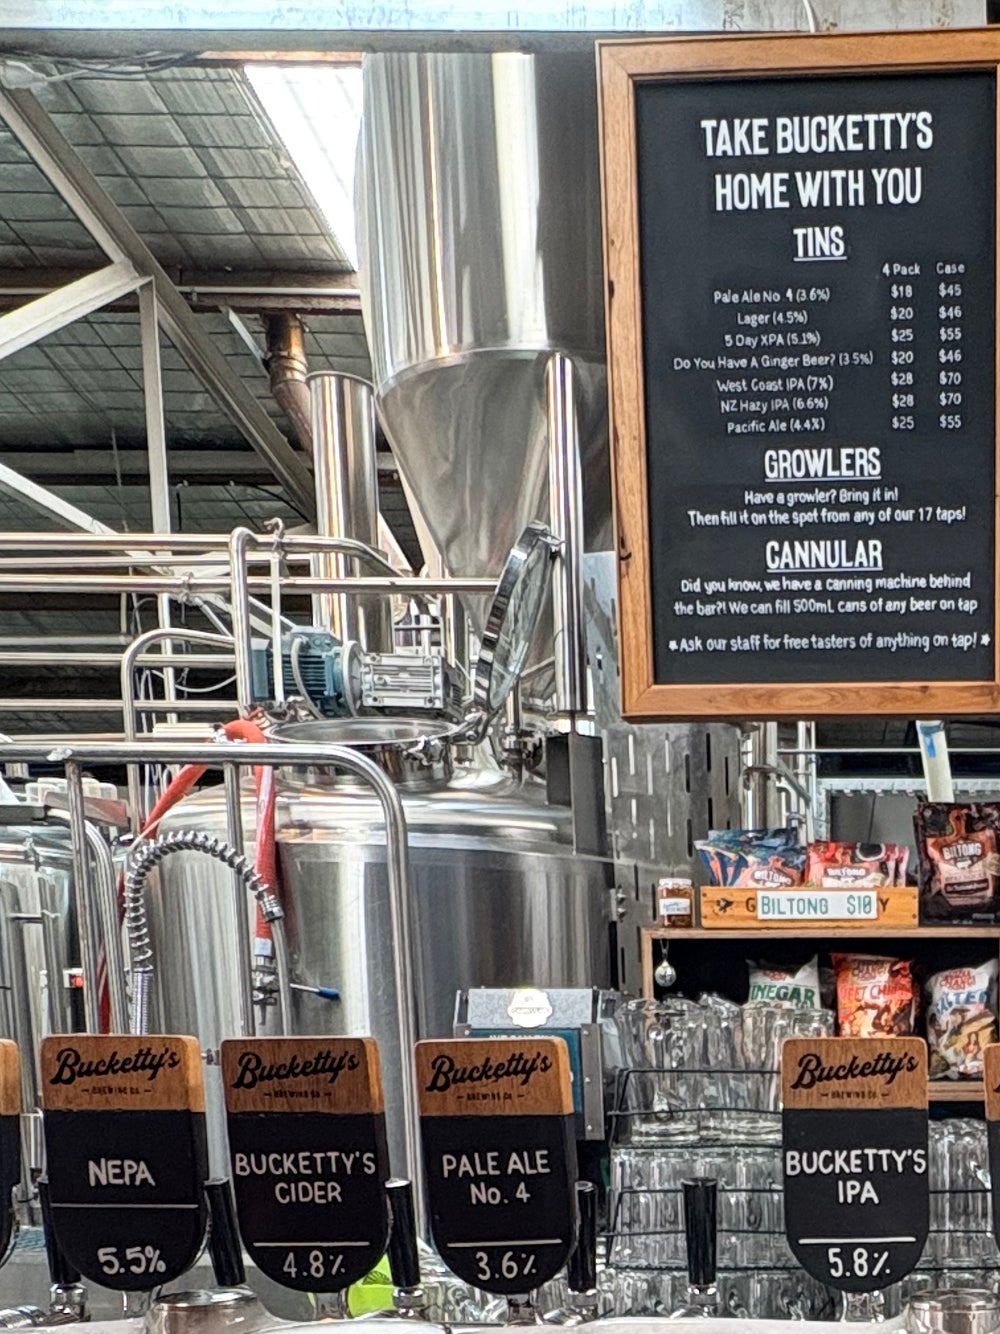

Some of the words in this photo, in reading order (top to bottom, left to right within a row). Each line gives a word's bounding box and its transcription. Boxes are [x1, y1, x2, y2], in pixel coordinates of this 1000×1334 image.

[701, 118, 769, 156] TAKE
[776, 112, 933, 153] BUCKETTY'S
[715, 173, 789, 210] HOME
[795, 171, 865, 207] WITH
[873, 168, 922, 204] YOU
[793, 226, 845, 257] TINS
[882, 264, 890, 277] 4
[893, 263, 920, 276] Pack
[936, 263, 964, 275] Case
[738, 312, 770, 327] Lager
[772, 310, 808, 326] (4.5%)
[890, 306, 914, 320] $20
[939, 306, 962, 320] $46
[717, 378, 747, 392] West
[751, 377, 784, 391] Coast
[786, 378, 806, 390] IPA
[807, 375, 834, 391] (7%)
[891, 372, 913, 386] $28
[939, 371, 961, 386] $70
[728, 418, 765, 434] Pacific
[768, 418, 786, 432] Ale
[790, 417, 826, 432] (4.4%)
[892, 416, 914, 430] $25
[940, 414, 962, 429] $55
[765, 448, 880, 478] GROWLERS
[766, 540, 882, 569] CANNULAR
[680, 637, 703, 652] Ask
[707, 639, 727, 651] our
[731, 634, 760, 651] staff
[763, 634, 781, 650] for
[784, 634, 809, 650] free
[811, 633, 856, 649] tasters
[860, 632, 873, 648] of
[876, 631, 929, 652] anything
[933, 634, 948, 647] on
[952, 631, 978, 649] tap!
[943, 843, 981, 860] BILTONG
[762, 896, 828, 915] BILTONG
[847, 895, 872, 915] $10
[50, 1047, 180, 1085] Bucketty's
[232, 1050, 359, 1089] Bucketty's
[426, 1052, 552, 1092] Bucketty's
[791, 1051, 918, 1089] Bucketty's
[89, 1158, 155, 1186] NEPA
[235, 1152, 376, 1176] BUCKETTY'S
[442, 1152, 500, 1177] PALE
[507, 1151, 549, 1174] ALE
[786, 1150, 926, 1176] BUCKETTY'S
[274, 1182, 342, 1202] CIDER
[471, 1184, 508, 1204] No.
[516, 1183, 531, 1201] 4
[838, 1181, 879, 1204] IPA
[97, 1246, 166, 1274] 5.5%
[283, 1251, 345, 1278] 4.8%
[476, 1252, 536, 1281] 3.6%
[828, 1248, 891, 1277] 5.8%
